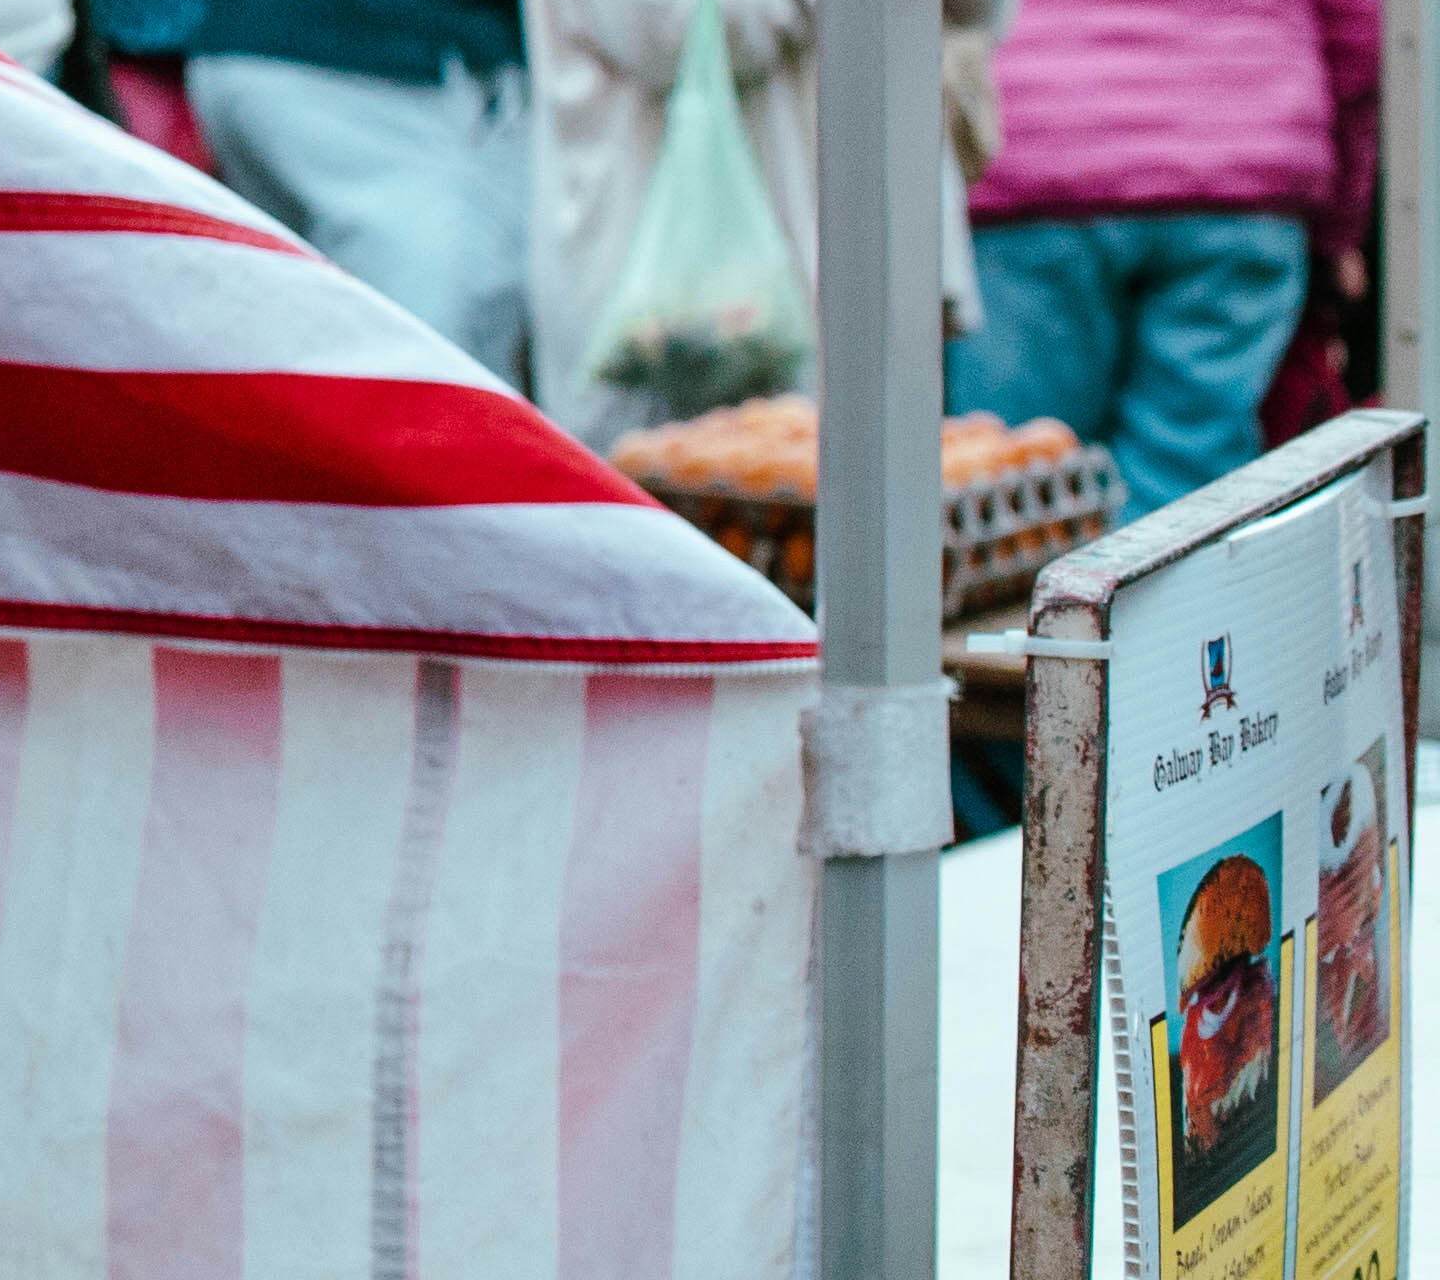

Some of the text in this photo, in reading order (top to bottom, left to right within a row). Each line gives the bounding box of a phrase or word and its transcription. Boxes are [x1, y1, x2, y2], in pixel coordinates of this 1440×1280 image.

[1154, 711, 1279, 792] Galway Bay Bakery
